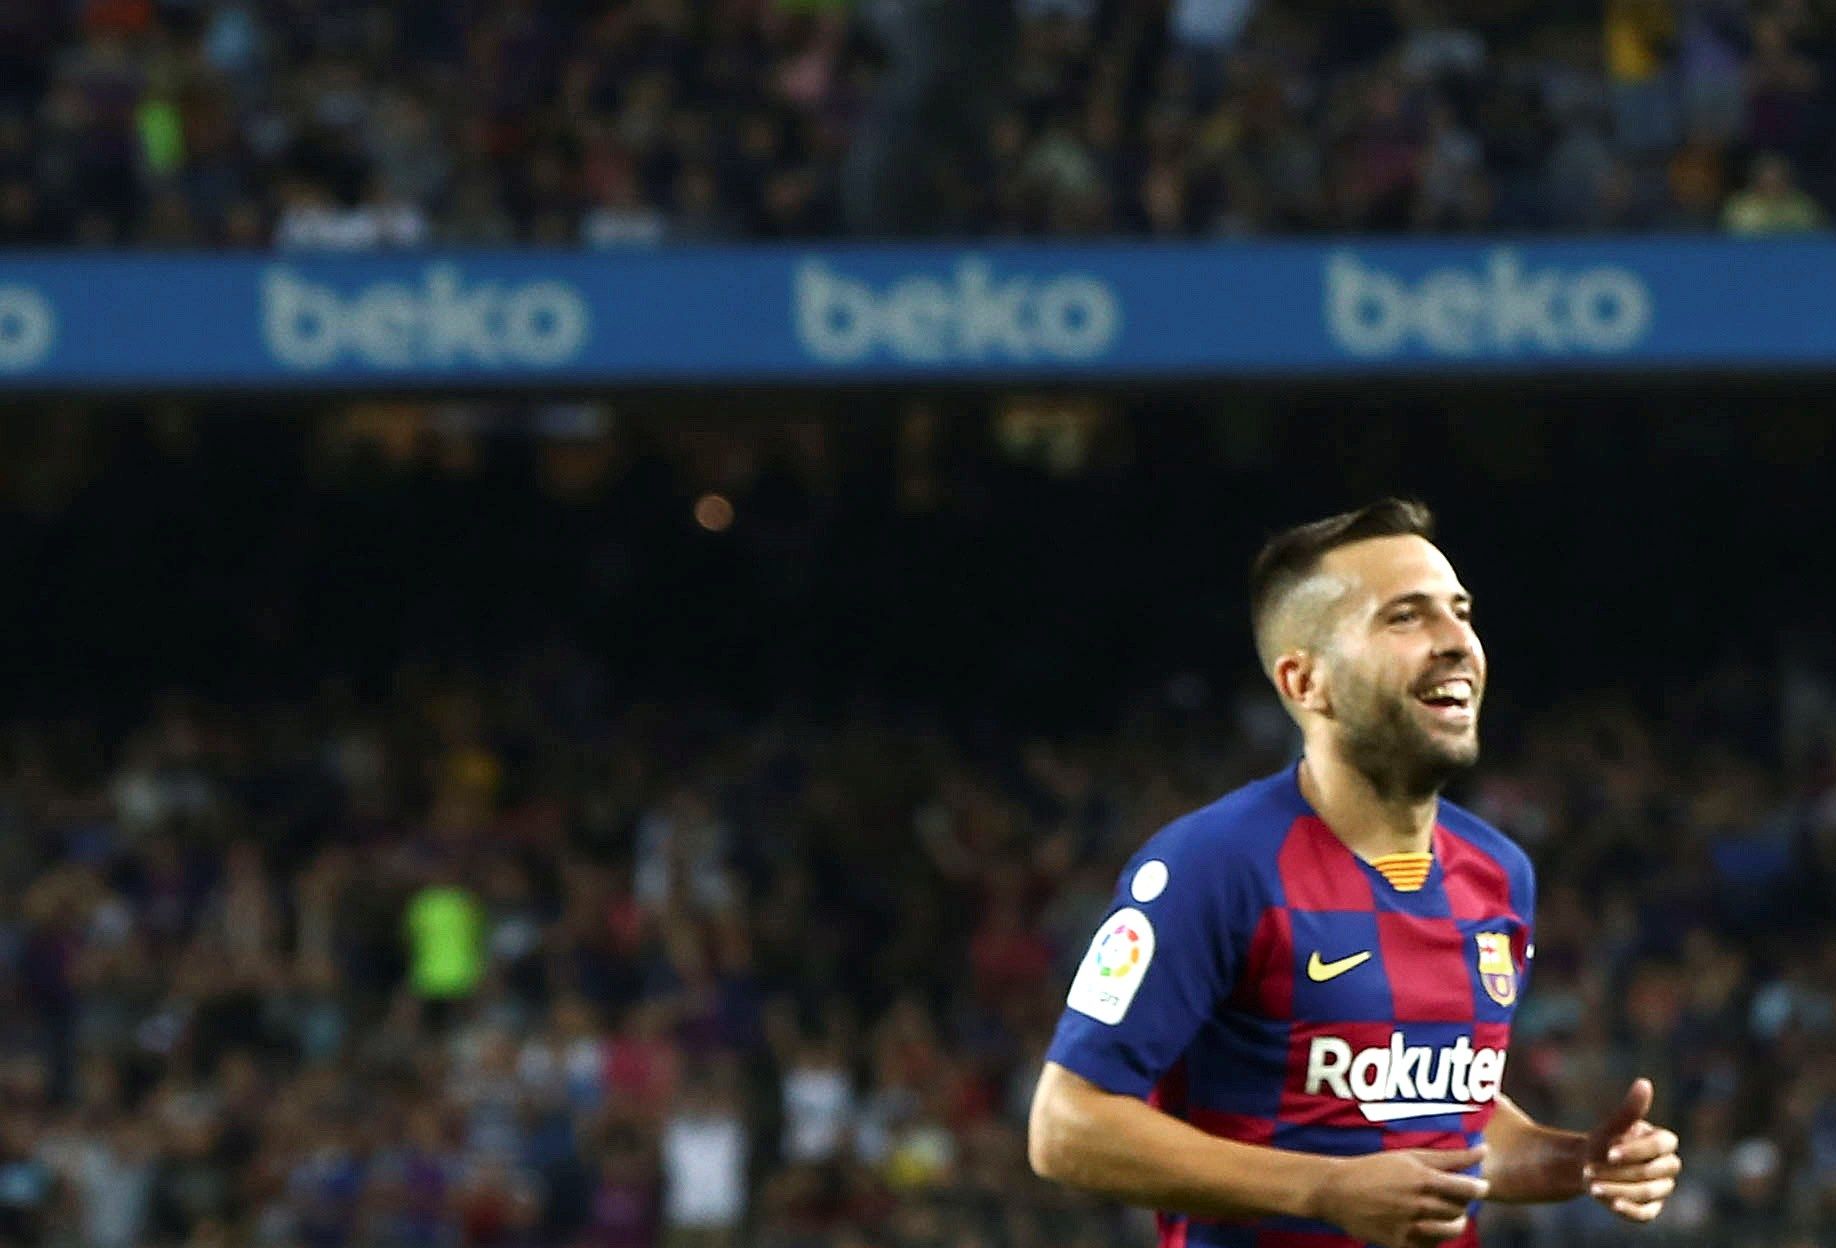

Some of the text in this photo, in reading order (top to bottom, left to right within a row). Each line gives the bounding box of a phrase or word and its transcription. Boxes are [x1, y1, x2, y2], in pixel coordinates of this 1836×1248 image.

[260, 264, 588, 370] beko
[795, 258, 1120, 362] beko
[1324, 252, 1650, 358] beko
